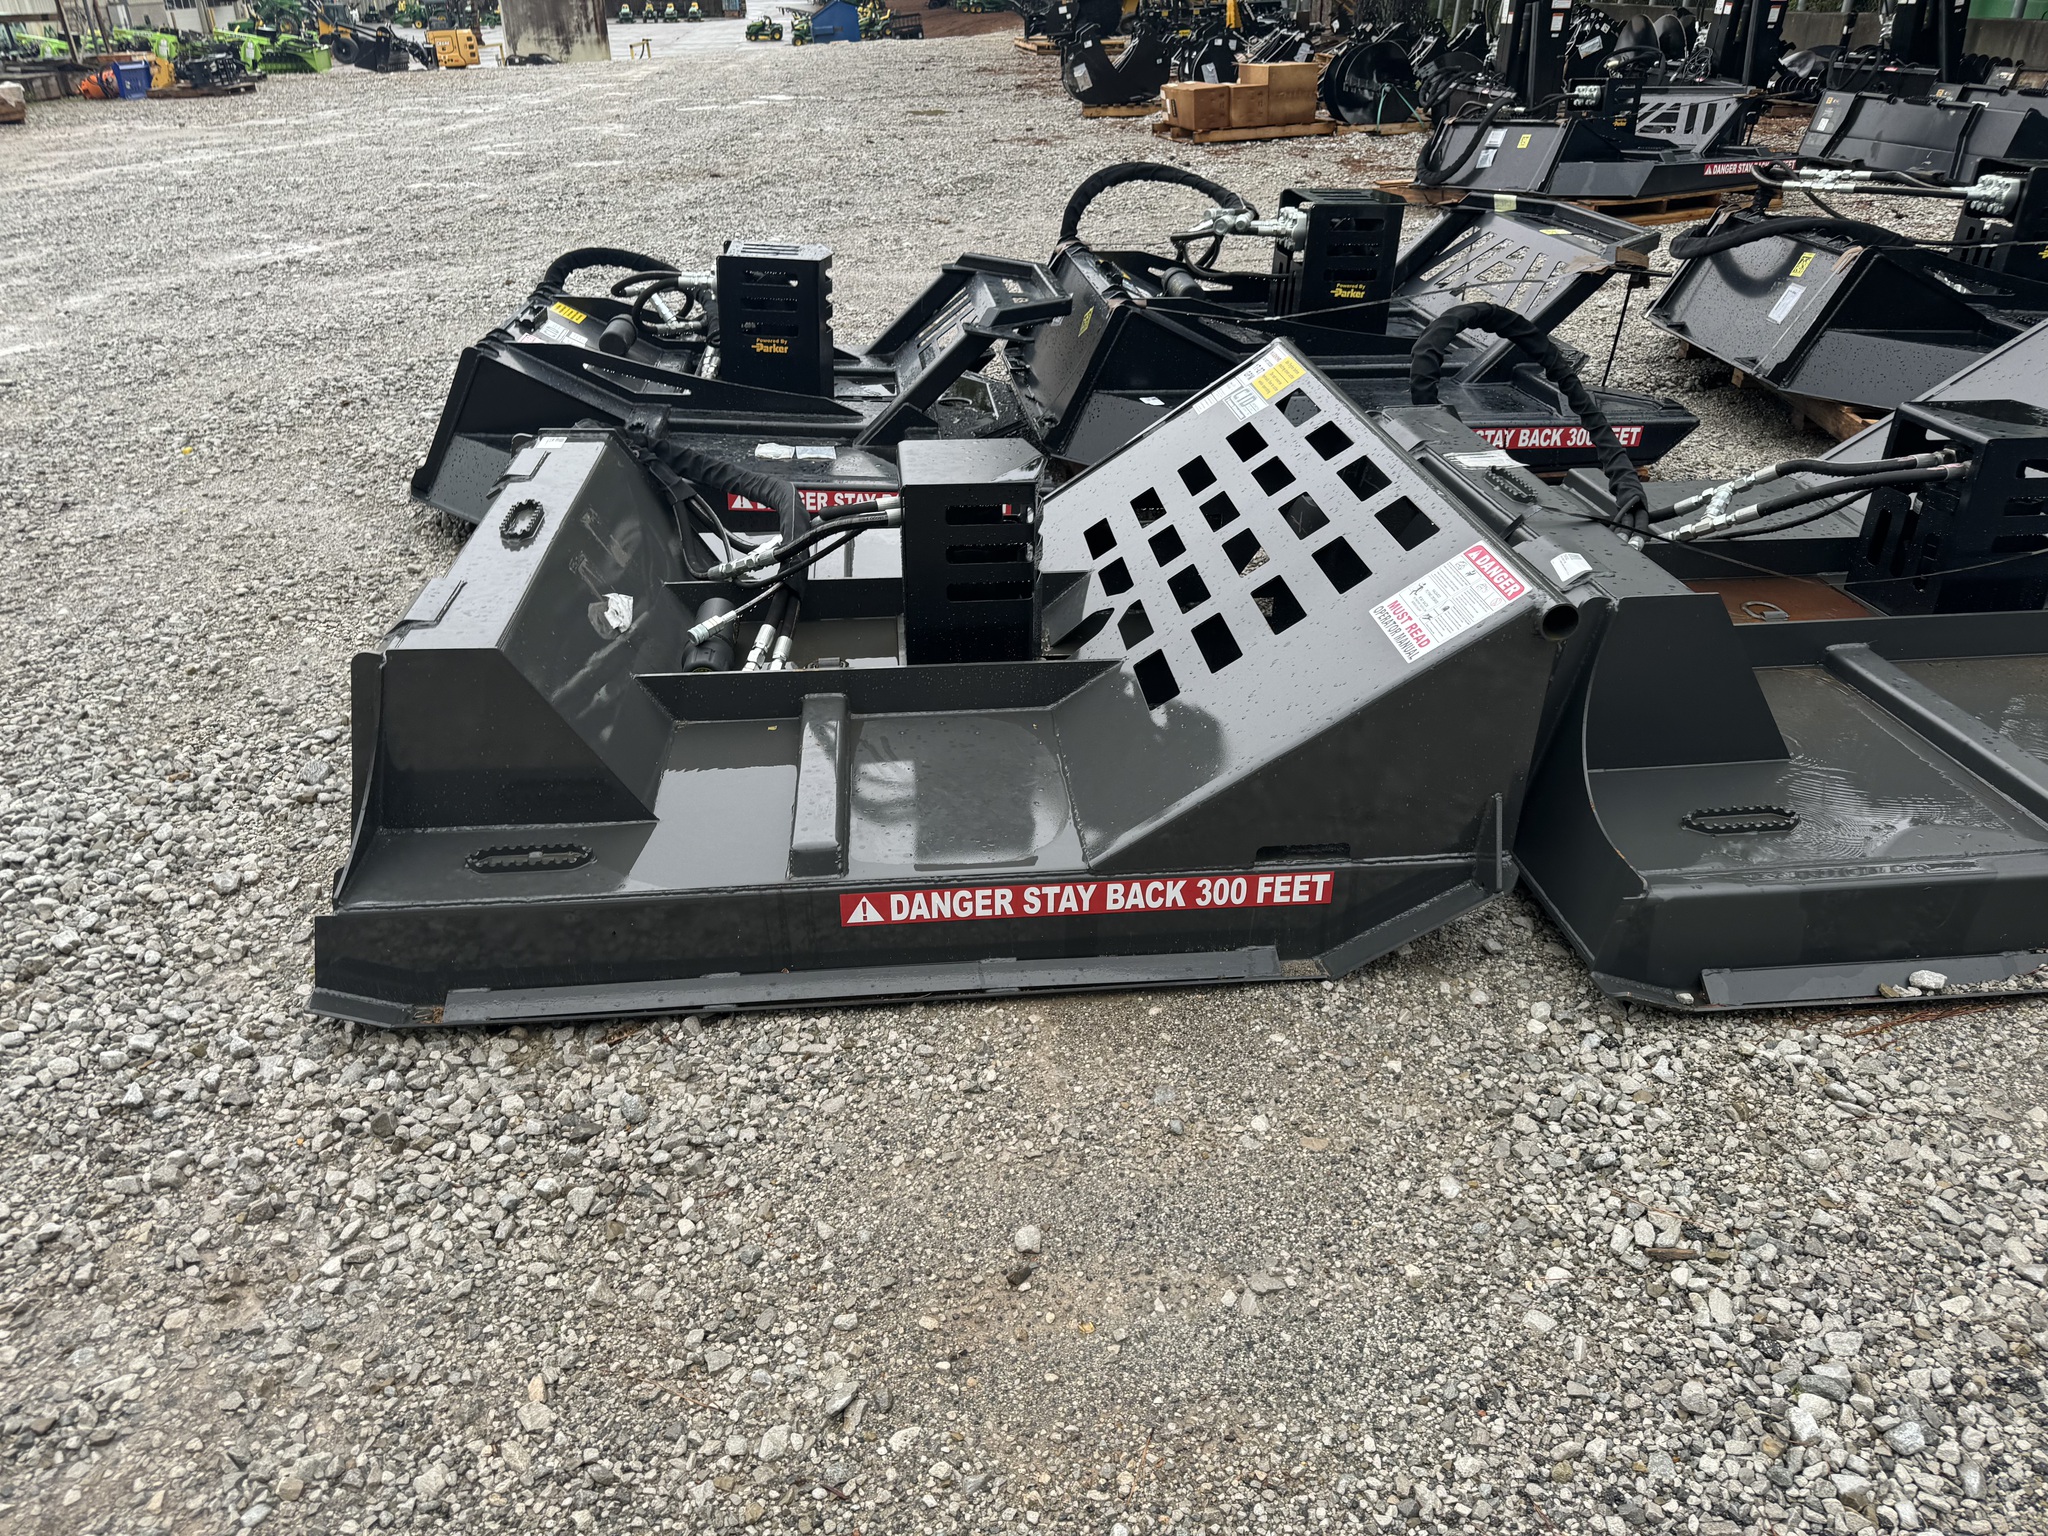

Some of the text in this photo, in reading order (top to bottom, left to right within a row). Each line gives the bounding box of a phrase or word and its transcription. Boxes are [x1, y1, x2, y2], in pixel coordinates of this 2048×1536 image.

[1712, 164, 1737, 175] DANGER
[1330, 287, 1366, 298] Parker
[751, 343, 789, 353] Parker
[1233, 387, 1257, 408] CID
[1518, 428, 1566, 447] BACK
[1475, 554, 1522, 596] DANGER
[1373, 606, 1420, 660] OPERATOR MANUAL
[1387, 600, 1413, 625] MUST
[1405, 620, 1431, 649] READ
[889, 874, 1331, 921] DANGER STAY BACK 300 FEET
